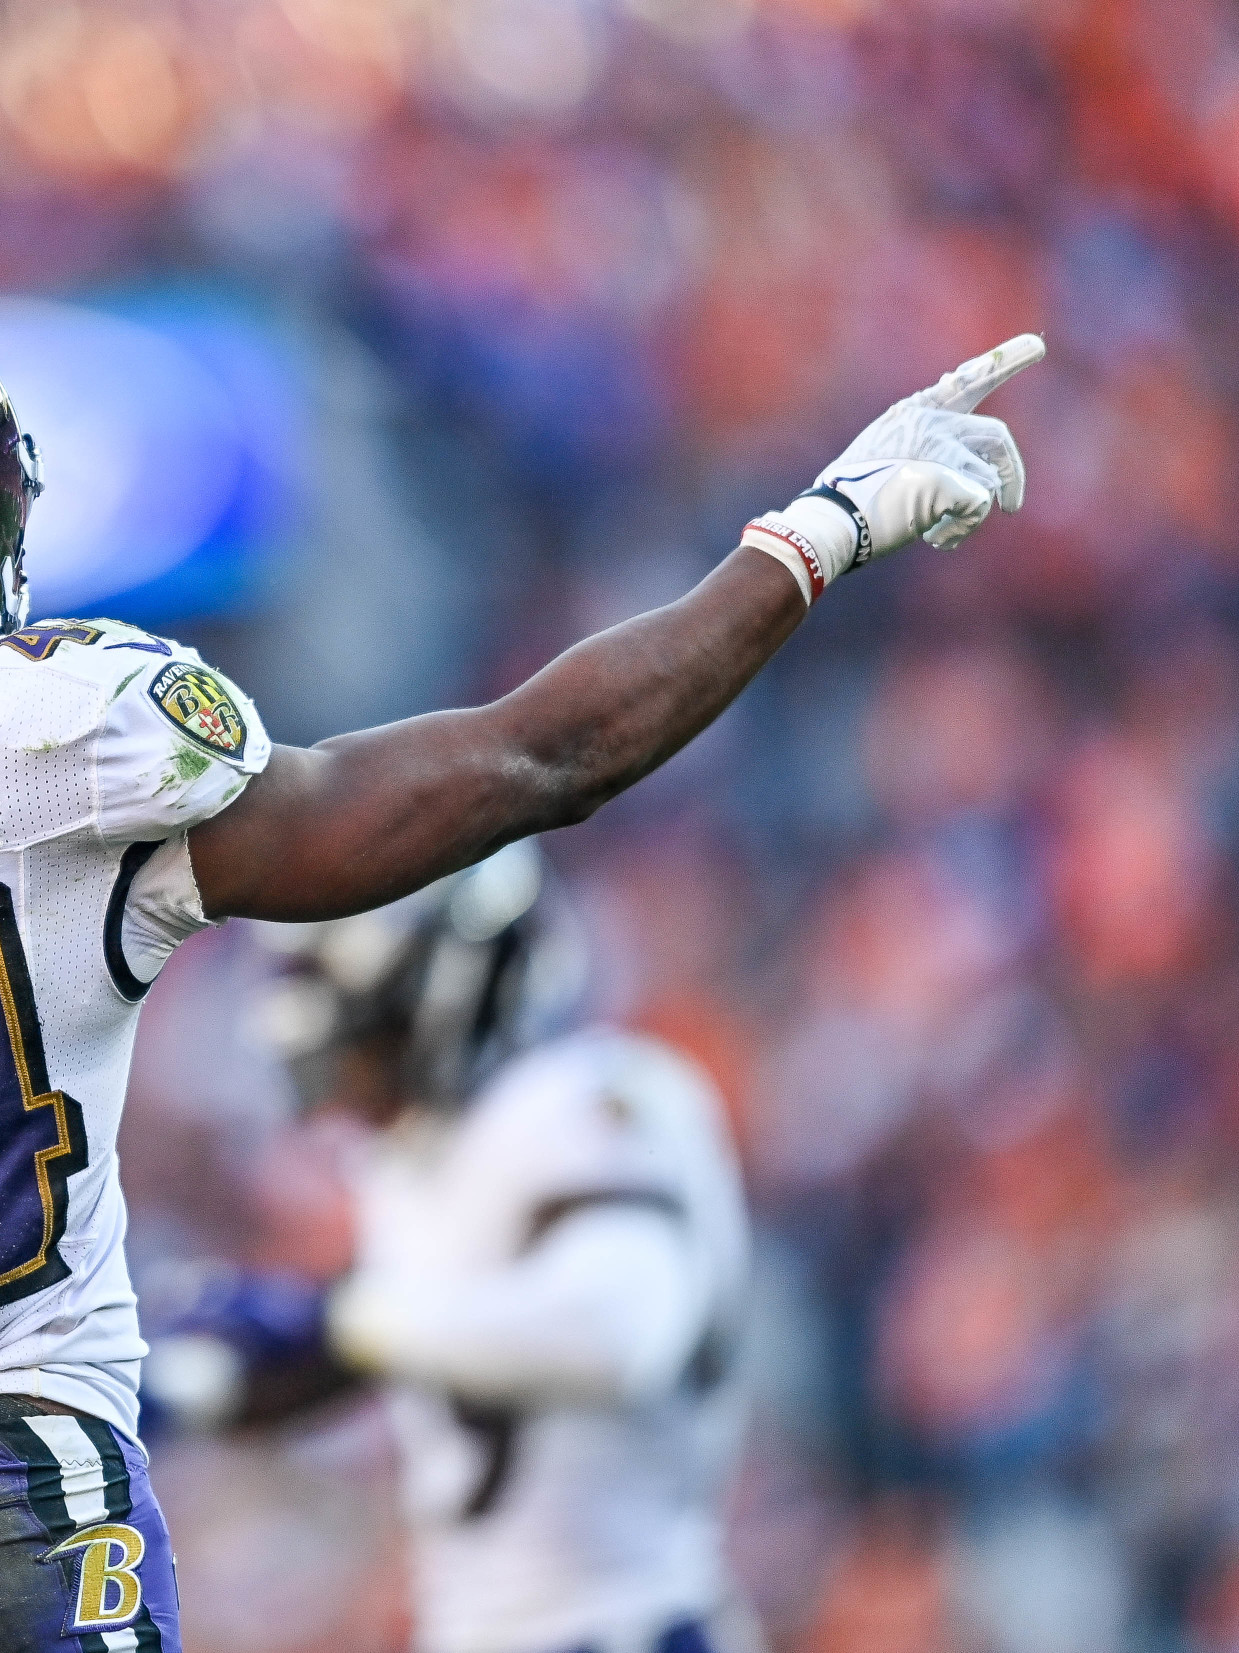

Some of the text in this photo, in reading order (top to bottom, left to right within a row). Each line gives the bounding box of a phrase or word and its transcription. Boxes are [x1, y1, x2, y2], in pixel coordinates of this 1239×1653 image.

[745, 518, 824, 580] INISH EMPTY
[45, 1522, 146, 1628] B
